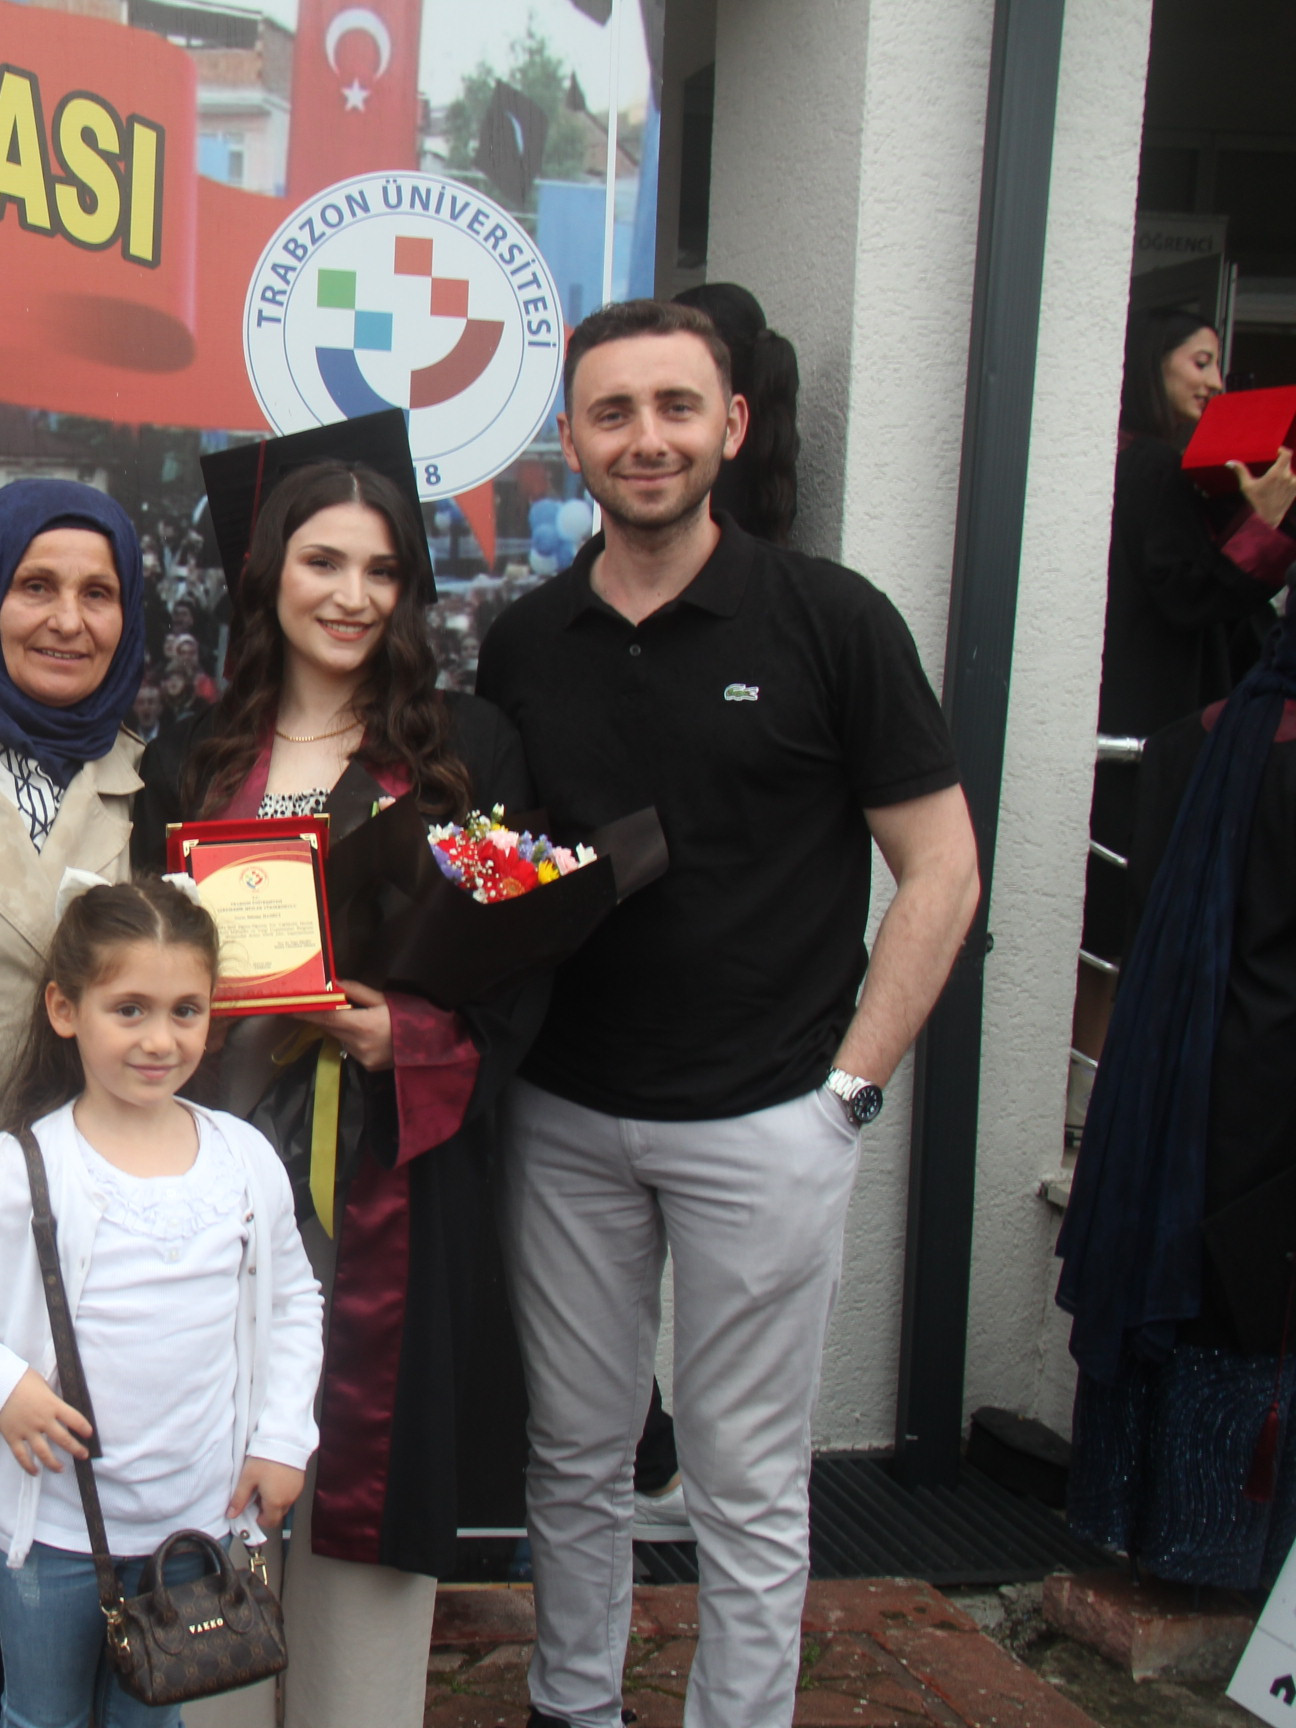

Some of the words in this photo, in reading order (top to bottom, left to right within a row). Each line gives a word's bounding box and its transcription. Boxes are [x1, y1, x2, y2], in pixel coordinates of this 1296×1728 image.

[256, 189, 371, 328] TRABZON
[381, 178, 557, 349] ÜNİVERSİTESİ
[188, 1617, 224, 1635] VAKKO
